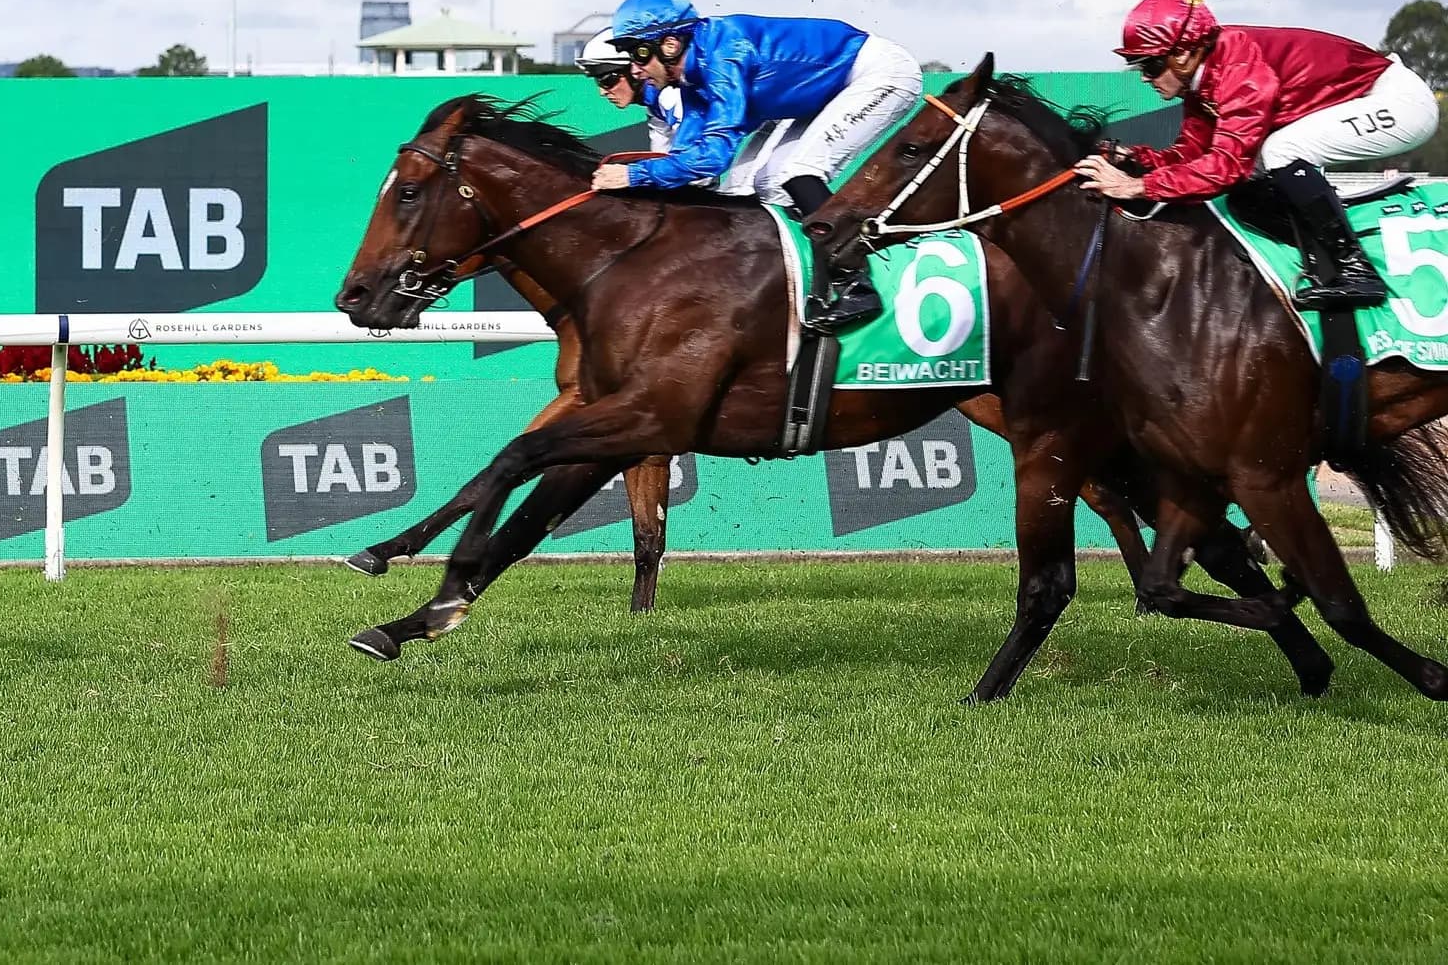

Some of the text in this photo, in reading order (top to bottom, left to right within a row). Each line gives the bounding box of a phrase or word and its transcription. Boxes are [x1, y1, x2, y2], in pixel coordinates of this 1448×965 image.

[1341, 109, 1396, 136] TJS
[64, 187, 245, 270] TAB
[894, 240, 976, 357] 6
[1379, 215, 1448, 337] 5
[155, 324, 208, 332] ROSEHILL
[212, 323, 263, 332] GARDENS
[451, 322, 501, 331] GARDENS
[856, 360, 980, 381] BEIWACHT
[278, 442, 401, 493] TAB
[842, 440, 962, 489] TAB
